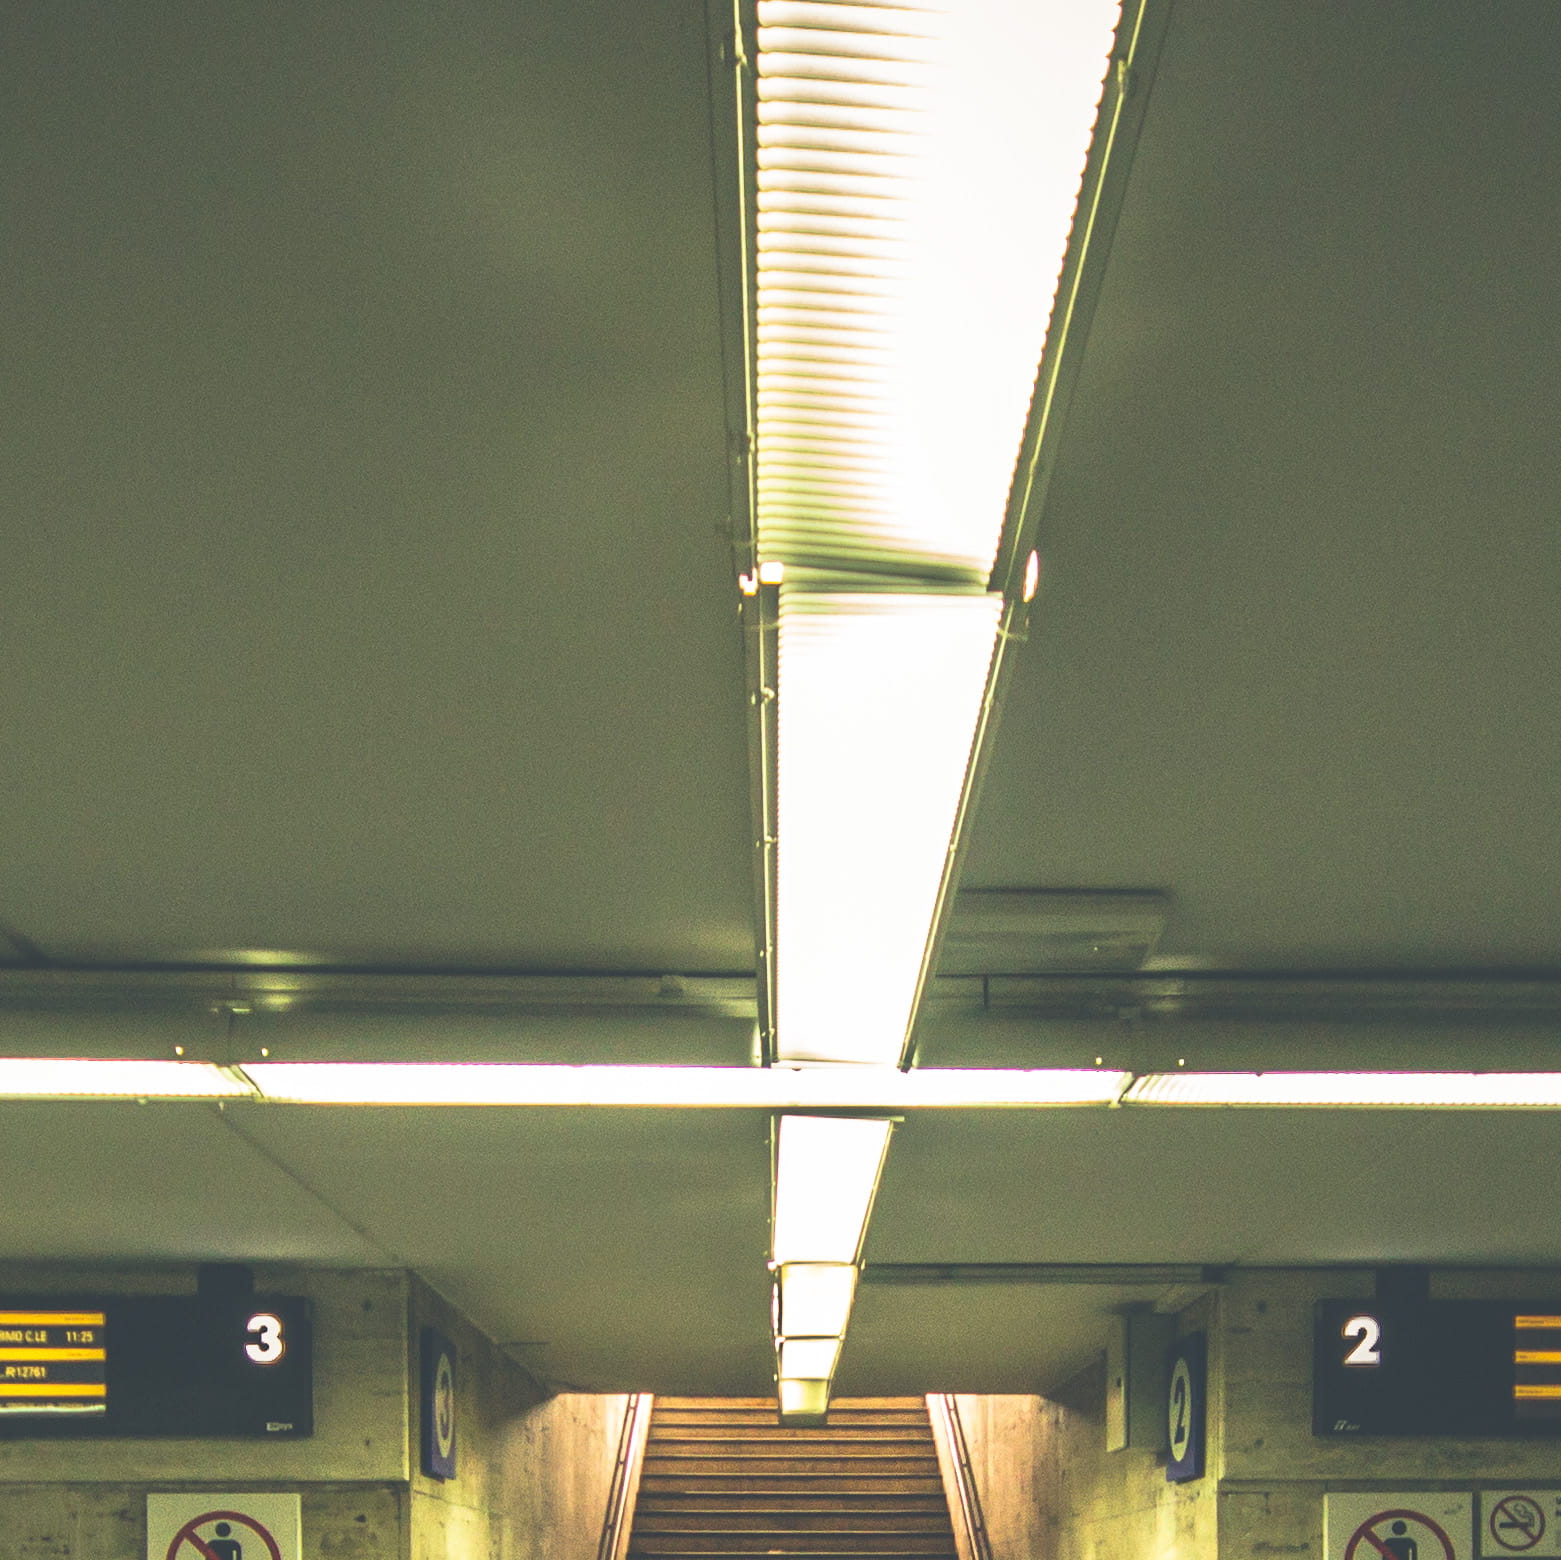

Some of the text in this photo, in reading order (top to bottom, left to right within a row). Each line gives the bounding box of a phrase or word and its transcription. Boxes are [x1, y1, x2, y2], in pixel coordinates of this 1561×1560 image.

[66, 1330, 94, 1343] 11:25
[244, 1312, 286, 1365] 3
[1341, 1313, 1382, 1366] 2
[1174, 1376, 1186, 1445] 2
